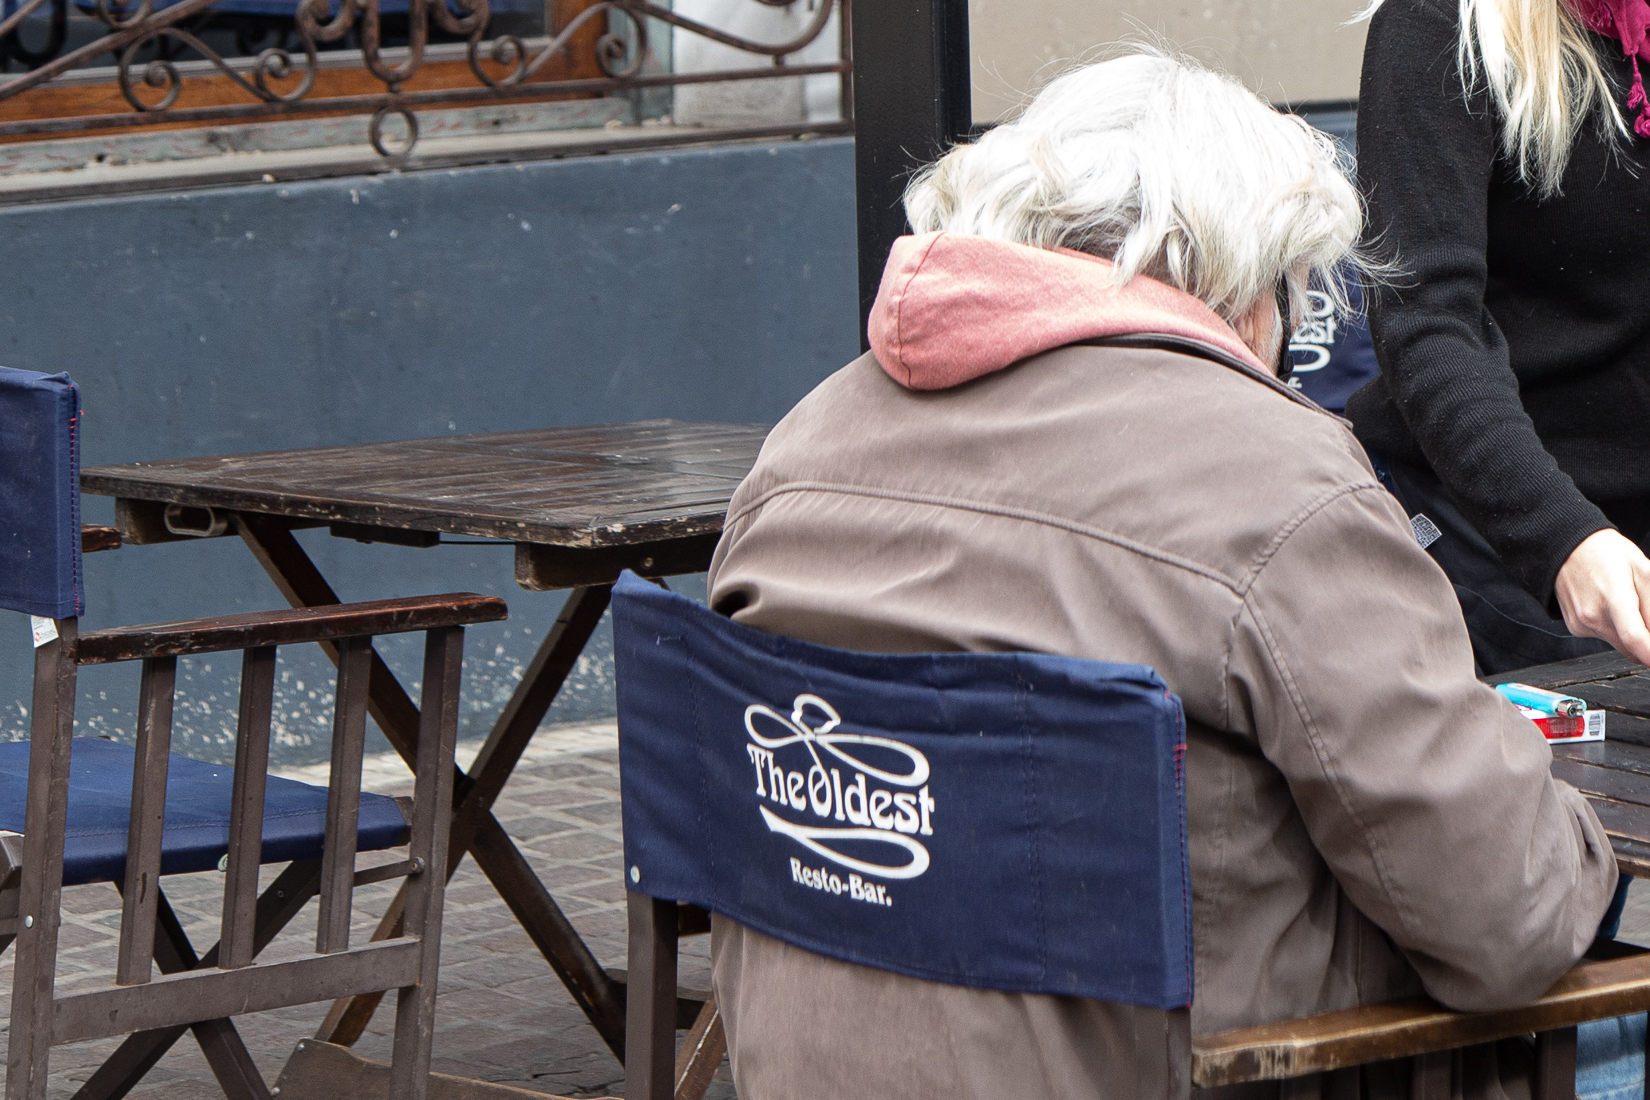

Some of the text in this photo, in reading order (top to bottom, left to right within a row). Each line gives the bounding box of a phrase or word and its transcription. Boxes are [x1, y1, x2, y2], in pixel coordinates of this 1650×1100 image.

[747, 743, 935, 836] The Oldest
[789, 856, 893, 907] Resto-Bar.
